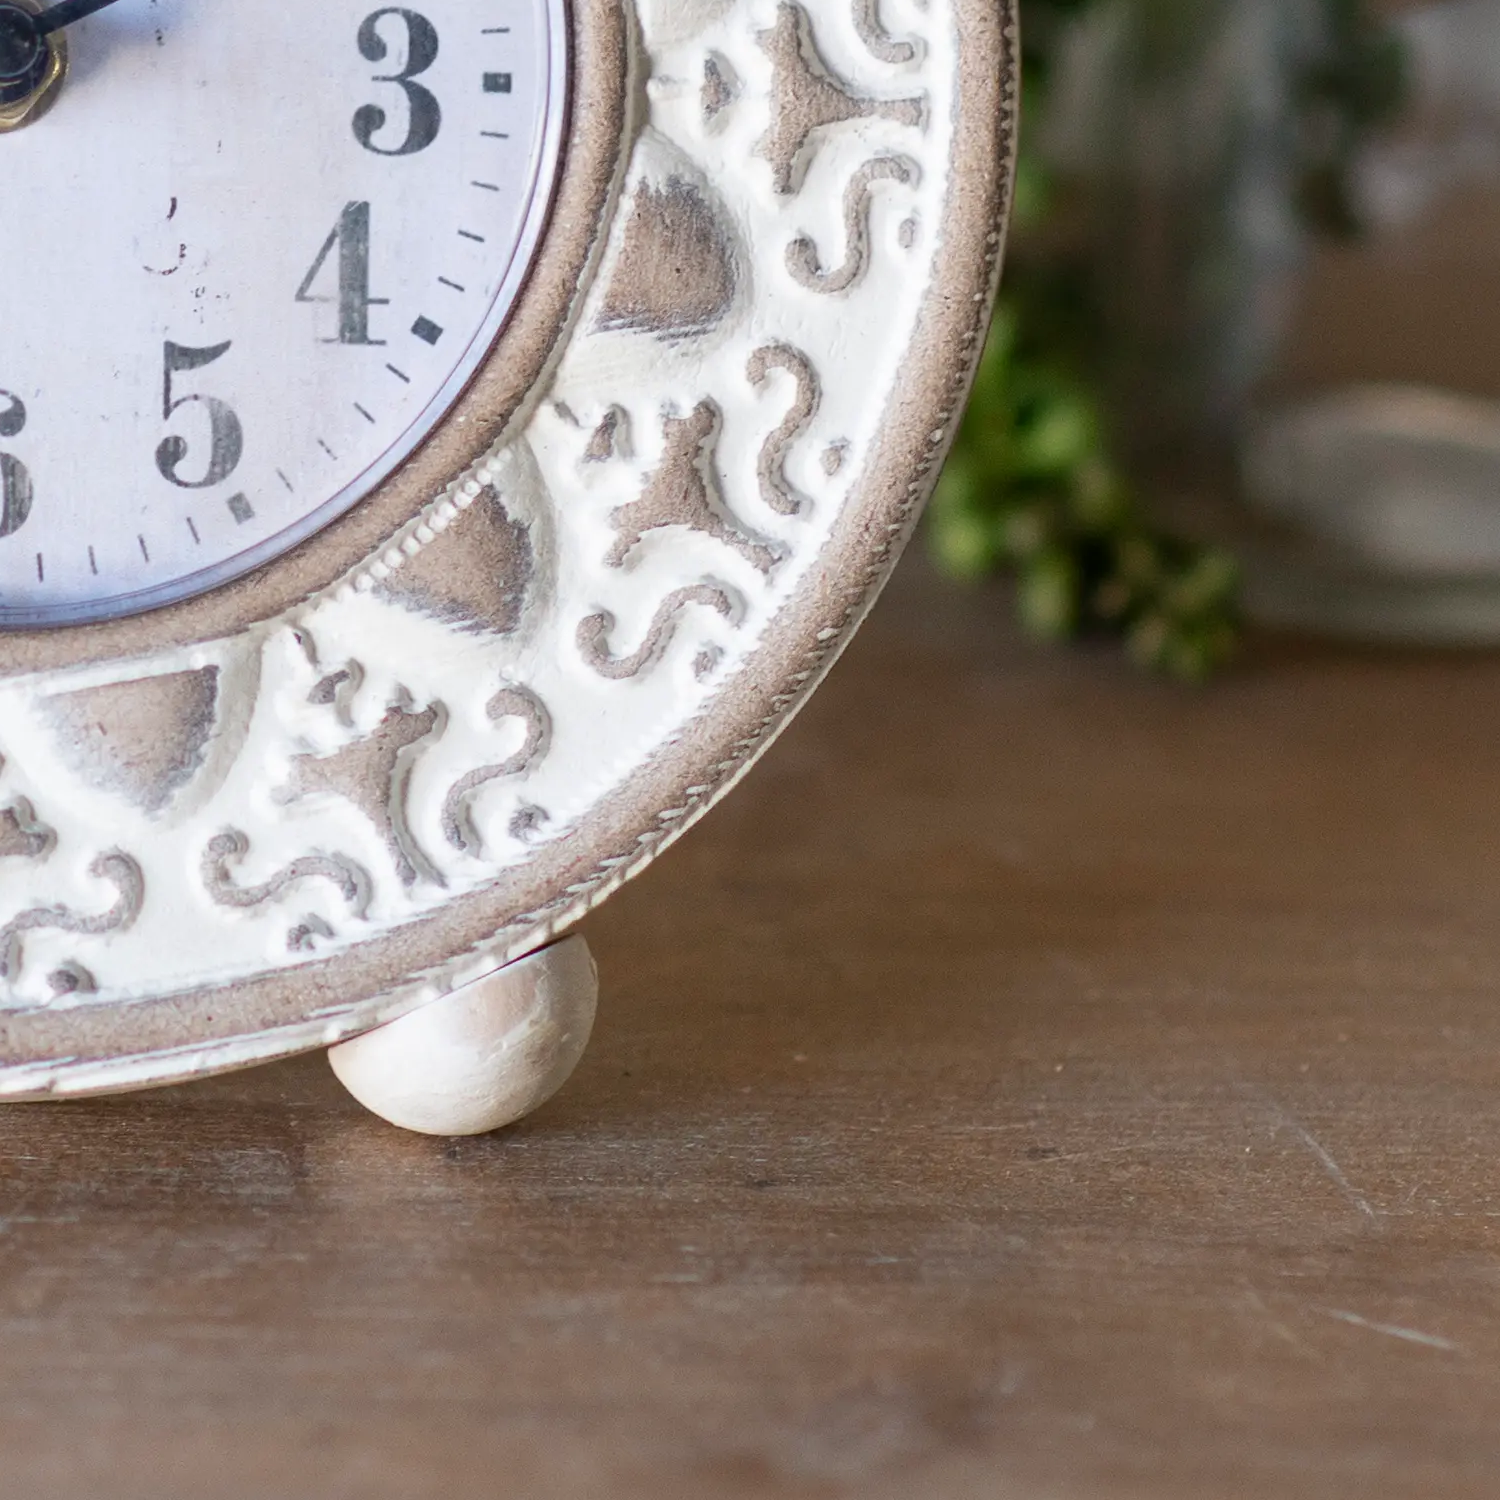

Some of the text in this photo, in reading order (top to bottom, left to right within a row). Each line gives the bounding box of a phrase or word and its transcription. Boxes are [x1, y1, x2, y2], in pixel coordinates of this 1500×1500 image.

[352, 8, 442, 156] 3
[295, 200, 389, 346] 4
[154, 339, 243, 489] 5
